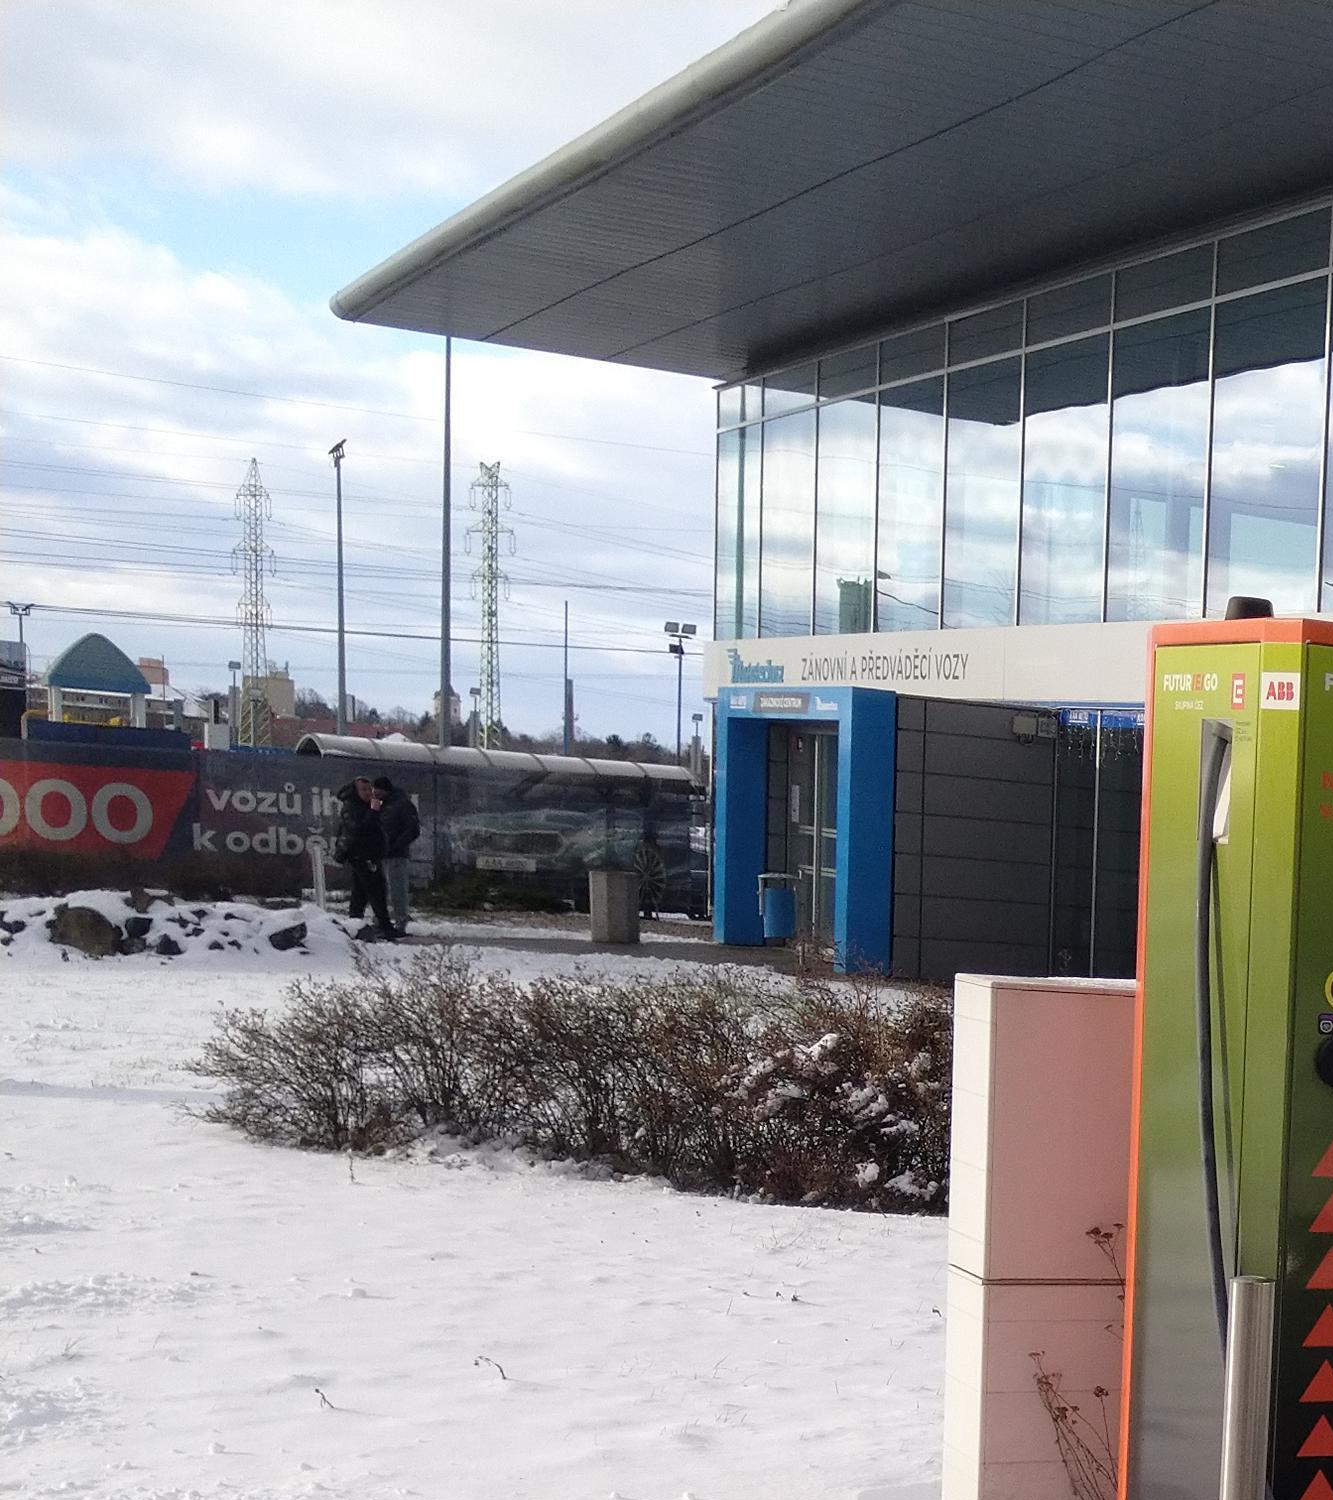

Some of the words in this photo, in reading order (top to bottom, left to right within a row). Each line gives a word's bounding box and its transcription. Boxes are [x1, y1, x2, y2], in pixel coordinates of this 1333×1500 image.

[801, 651, 848, 681] ZÁNOVNÍ
[849, 658, 858, 681] A
[861, 647, 933, 681] PŘEDVÁDĚCÍ
[935, 653, 969, 681] VOZY
[1266, 681, 1294, 701] ABB
[206, 783, 302, 815] vozů
[193, 823, 217, 852] k
